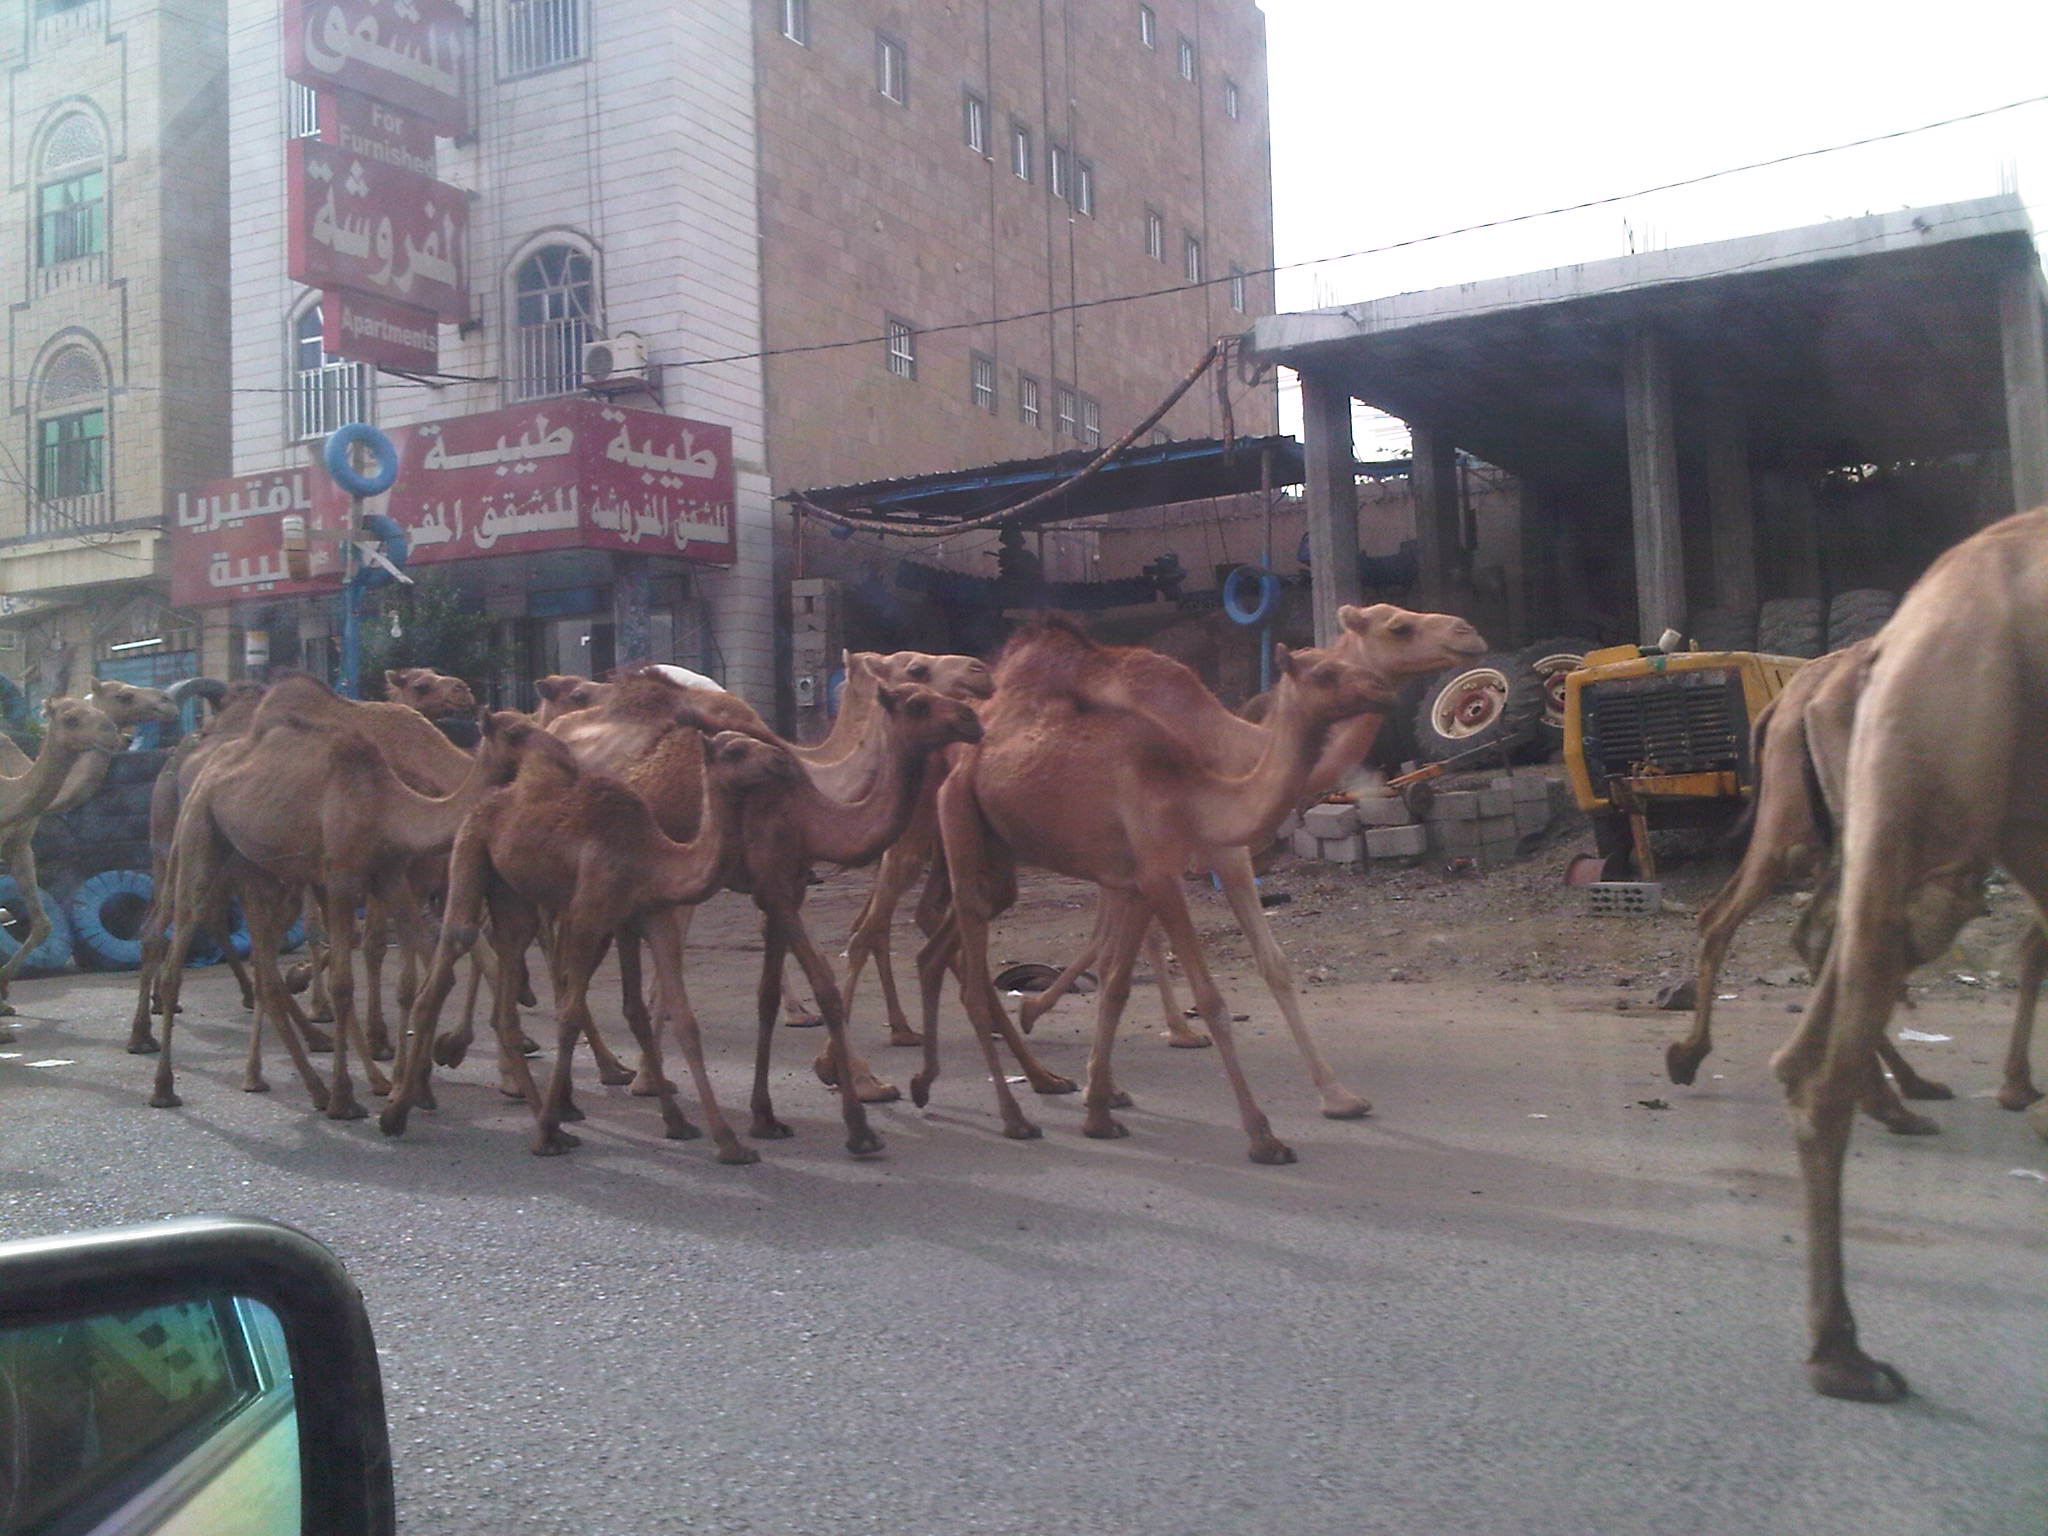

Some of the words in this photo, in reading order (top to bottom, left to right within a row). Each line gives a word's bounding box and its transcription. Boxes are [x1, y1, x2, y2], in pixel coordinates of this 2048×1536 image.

[372, 103, 404, 136] For
[340, 122, 437, 177] Furnished
[342, 306, 438, 351] Apartments
[419, 414, 574, 476] طيبة
[601, 408, 717, 490] طيبة
[178, 475, 312, 534] افتيريا
[474, 485, 579, 549] للشقق
[673, 501, 729, 550] للشقق
